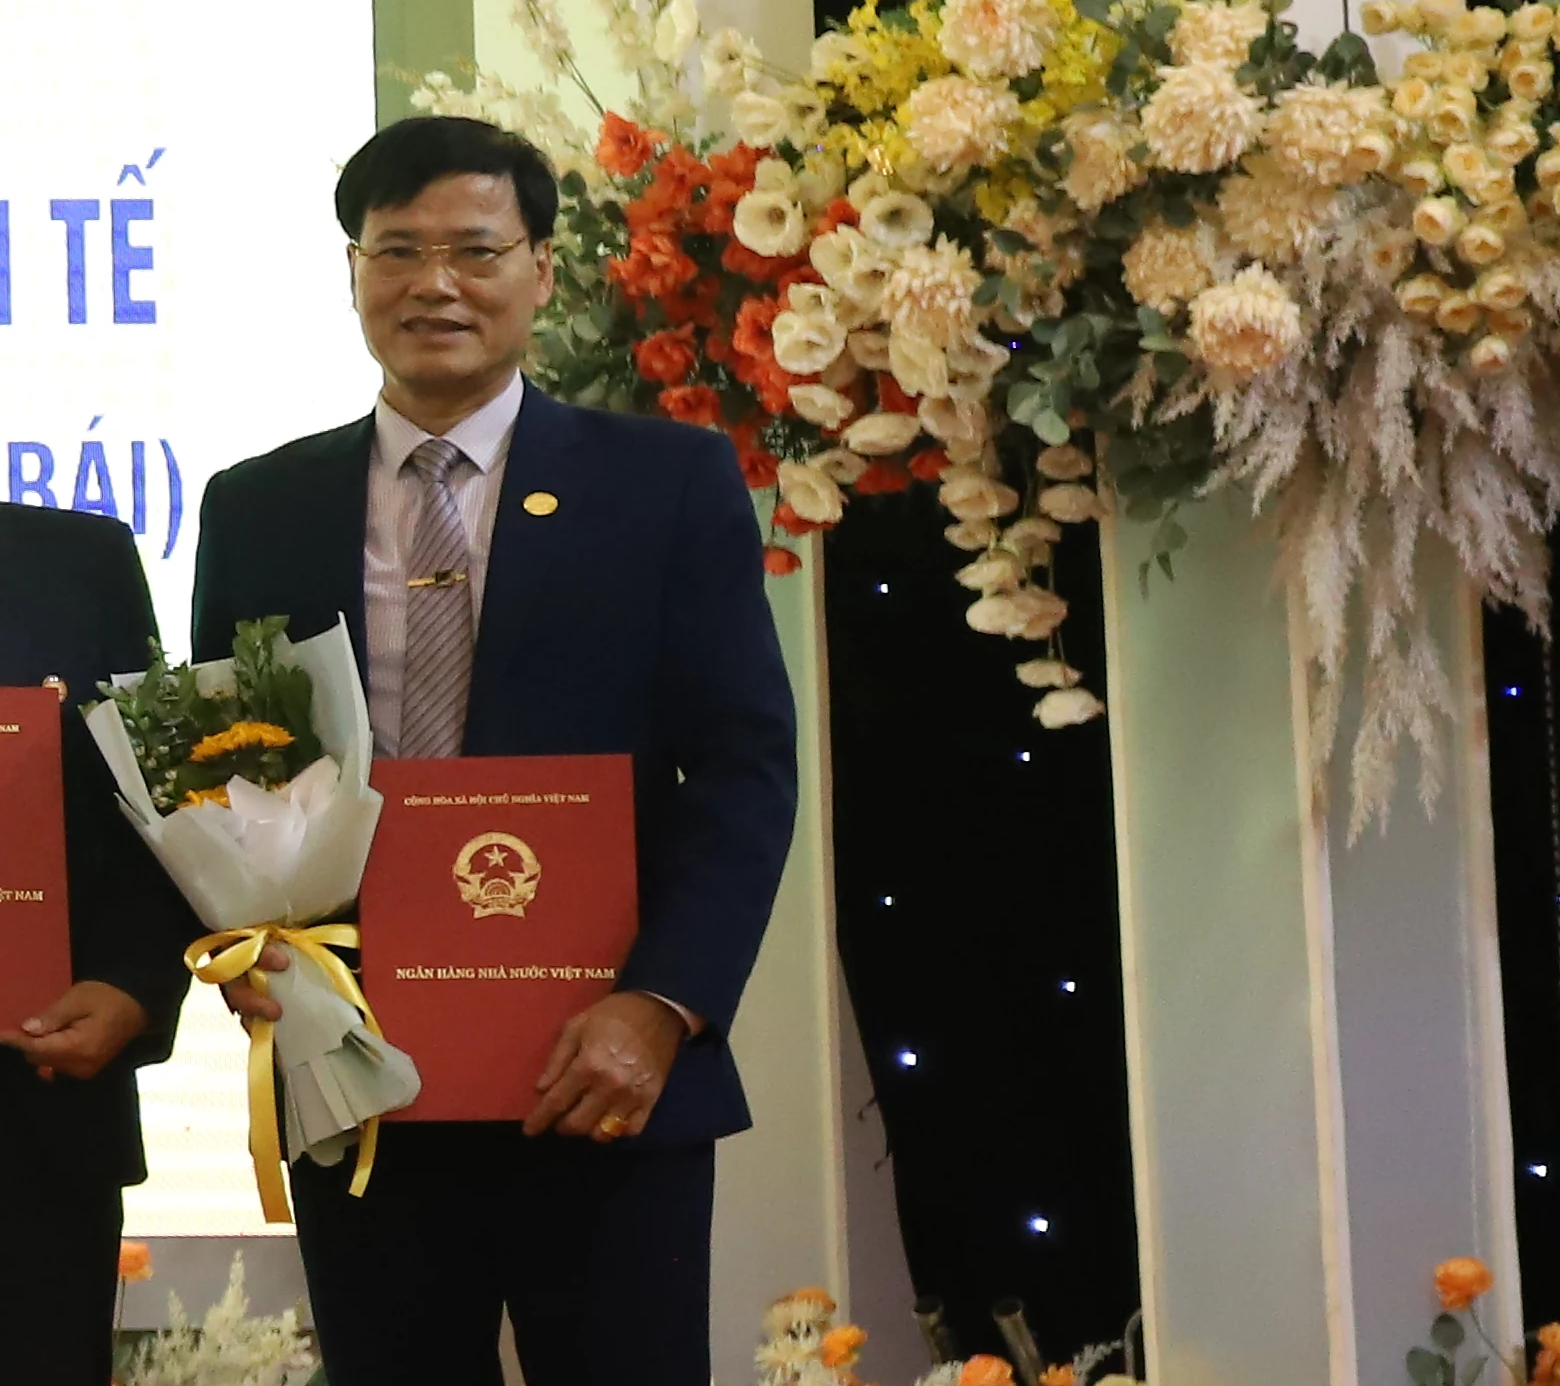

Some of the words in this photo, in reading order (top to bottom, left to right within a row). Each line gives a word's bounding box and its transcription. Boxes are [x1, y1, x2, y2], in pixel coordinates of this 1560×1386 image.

[50, 148, 165, 325] TẾ
[15, 890, 43, 901] NAM
[396, 965, 434, 979] NGÂN
[436, 965, 475, 979] HÀNG
[478, 964, 508, 979] NHÀ
[509, 964, 548, 979] NƯỚC
[550, 966, 585, 980] VIỆT
[585, 968, 615, 978] NAM
